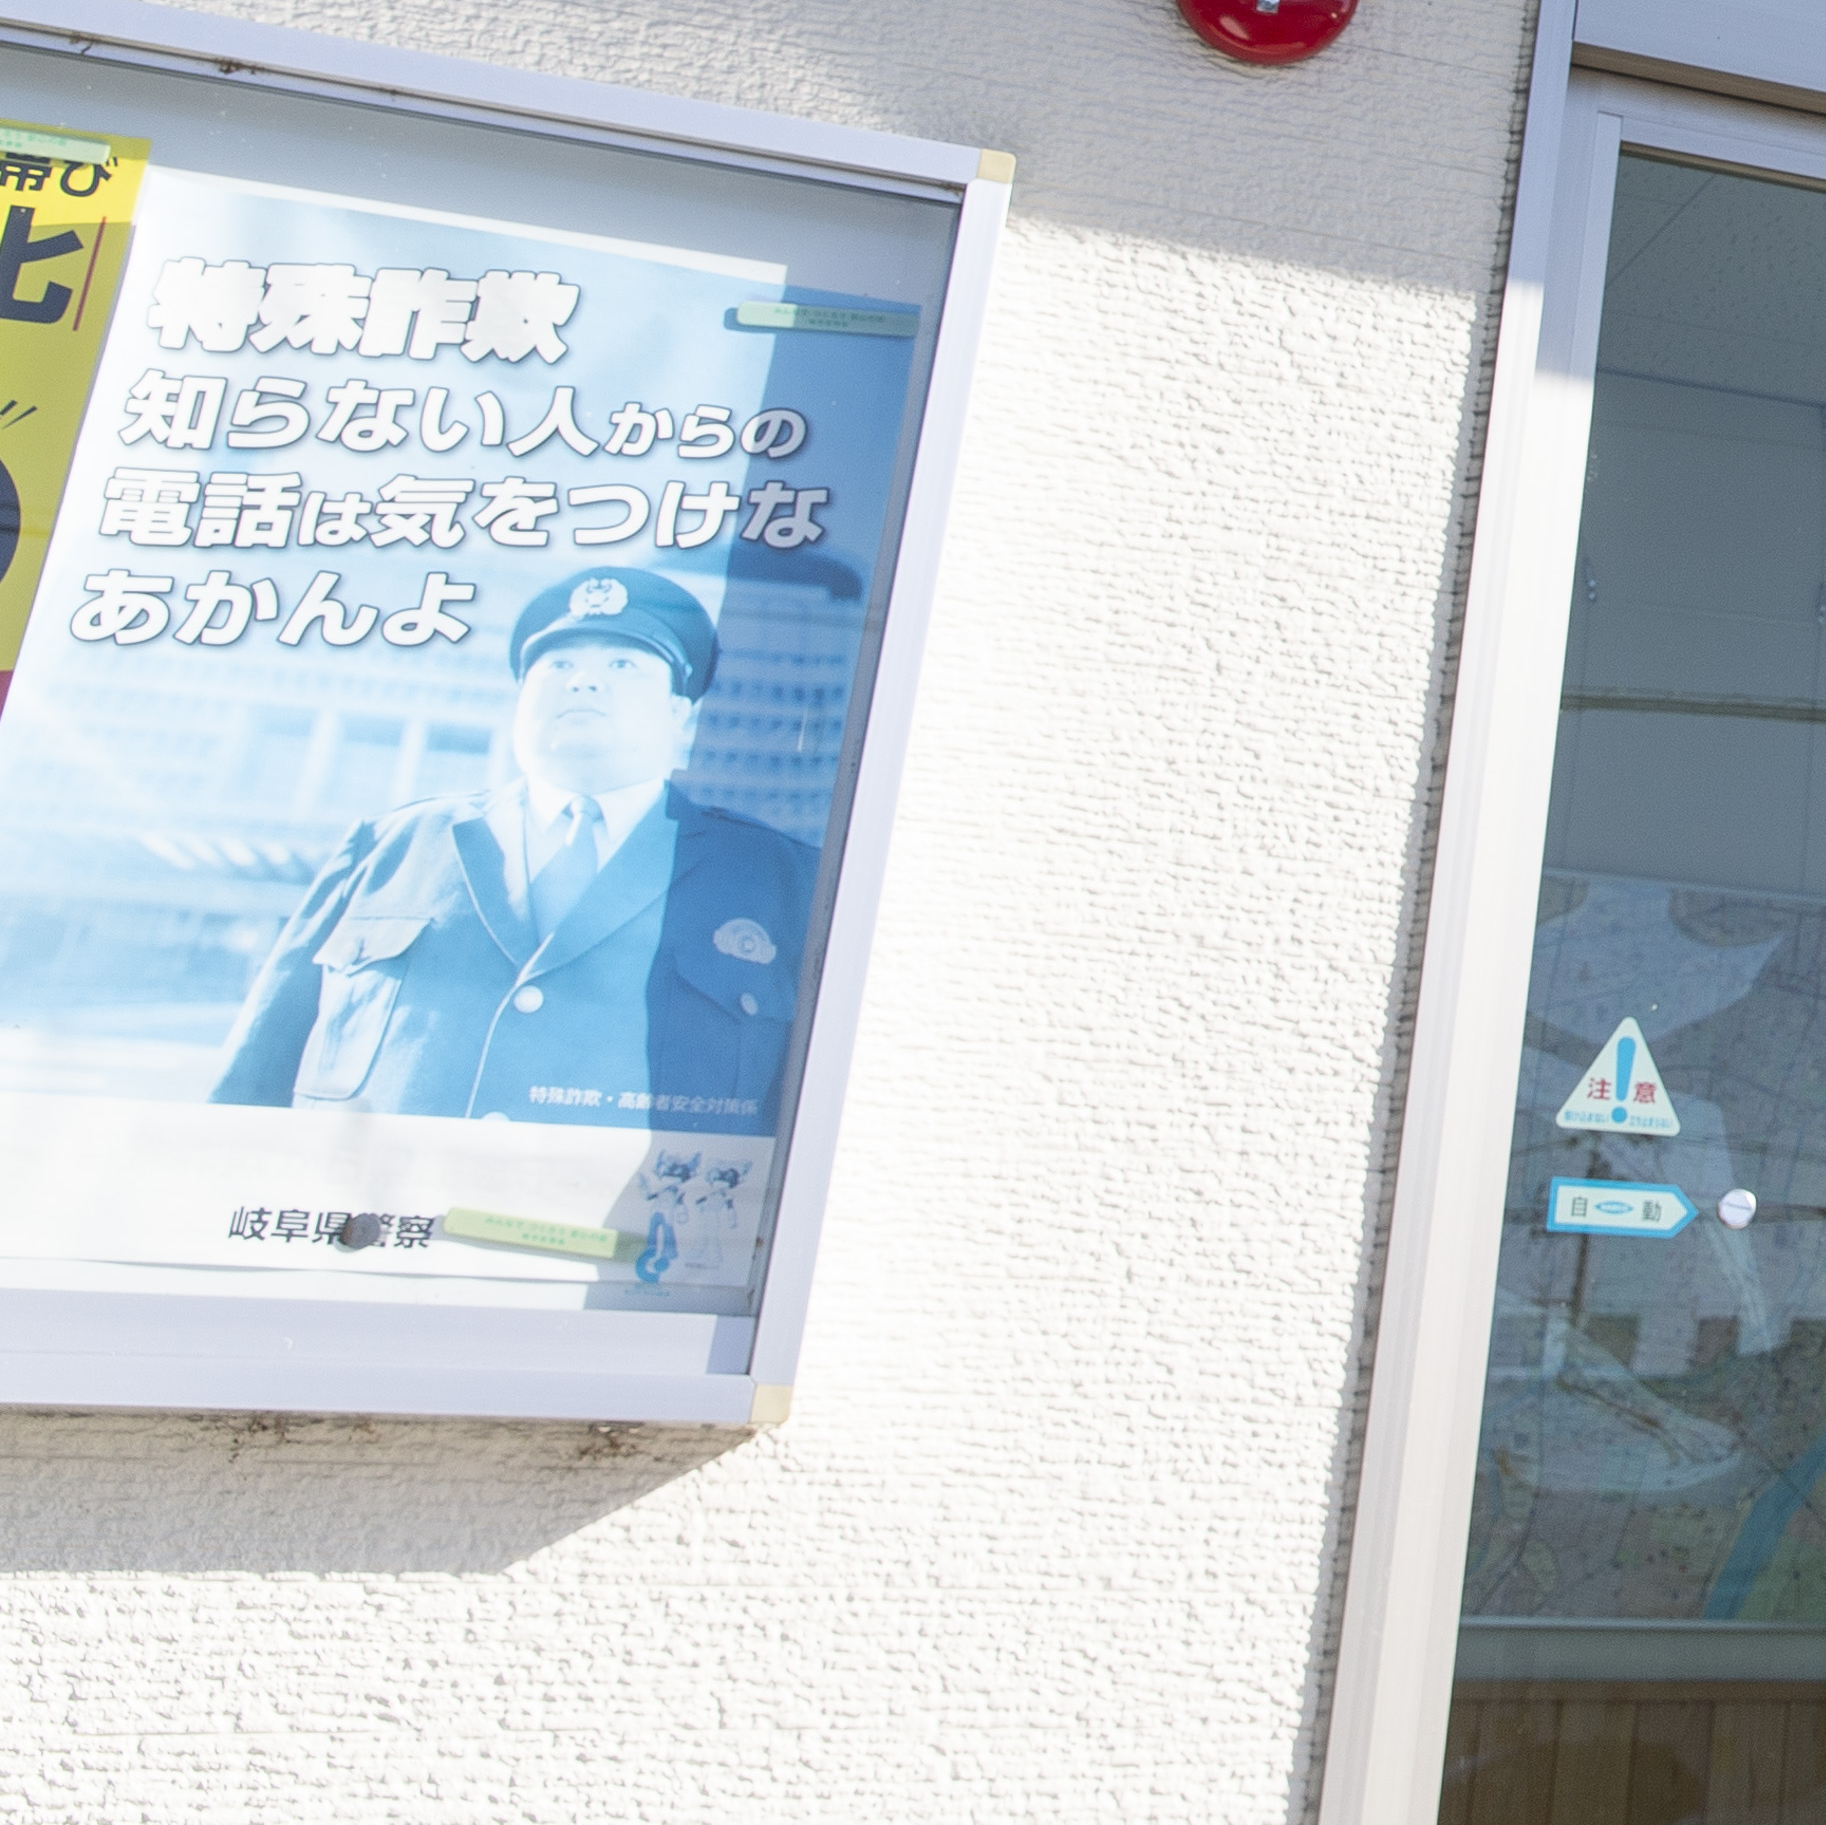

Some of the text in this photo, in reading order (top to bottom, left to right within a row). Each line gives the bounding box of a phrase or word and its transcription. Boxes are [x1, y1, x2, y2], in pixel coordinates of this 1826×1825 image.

[148, 257, 581, 364] 特殊詐欺
[118, 369, 808, 462] 知らない人からの
[98, 466, 831, 550] 電話は気をつけな
[69, 569, 478, 647] あかんよ
